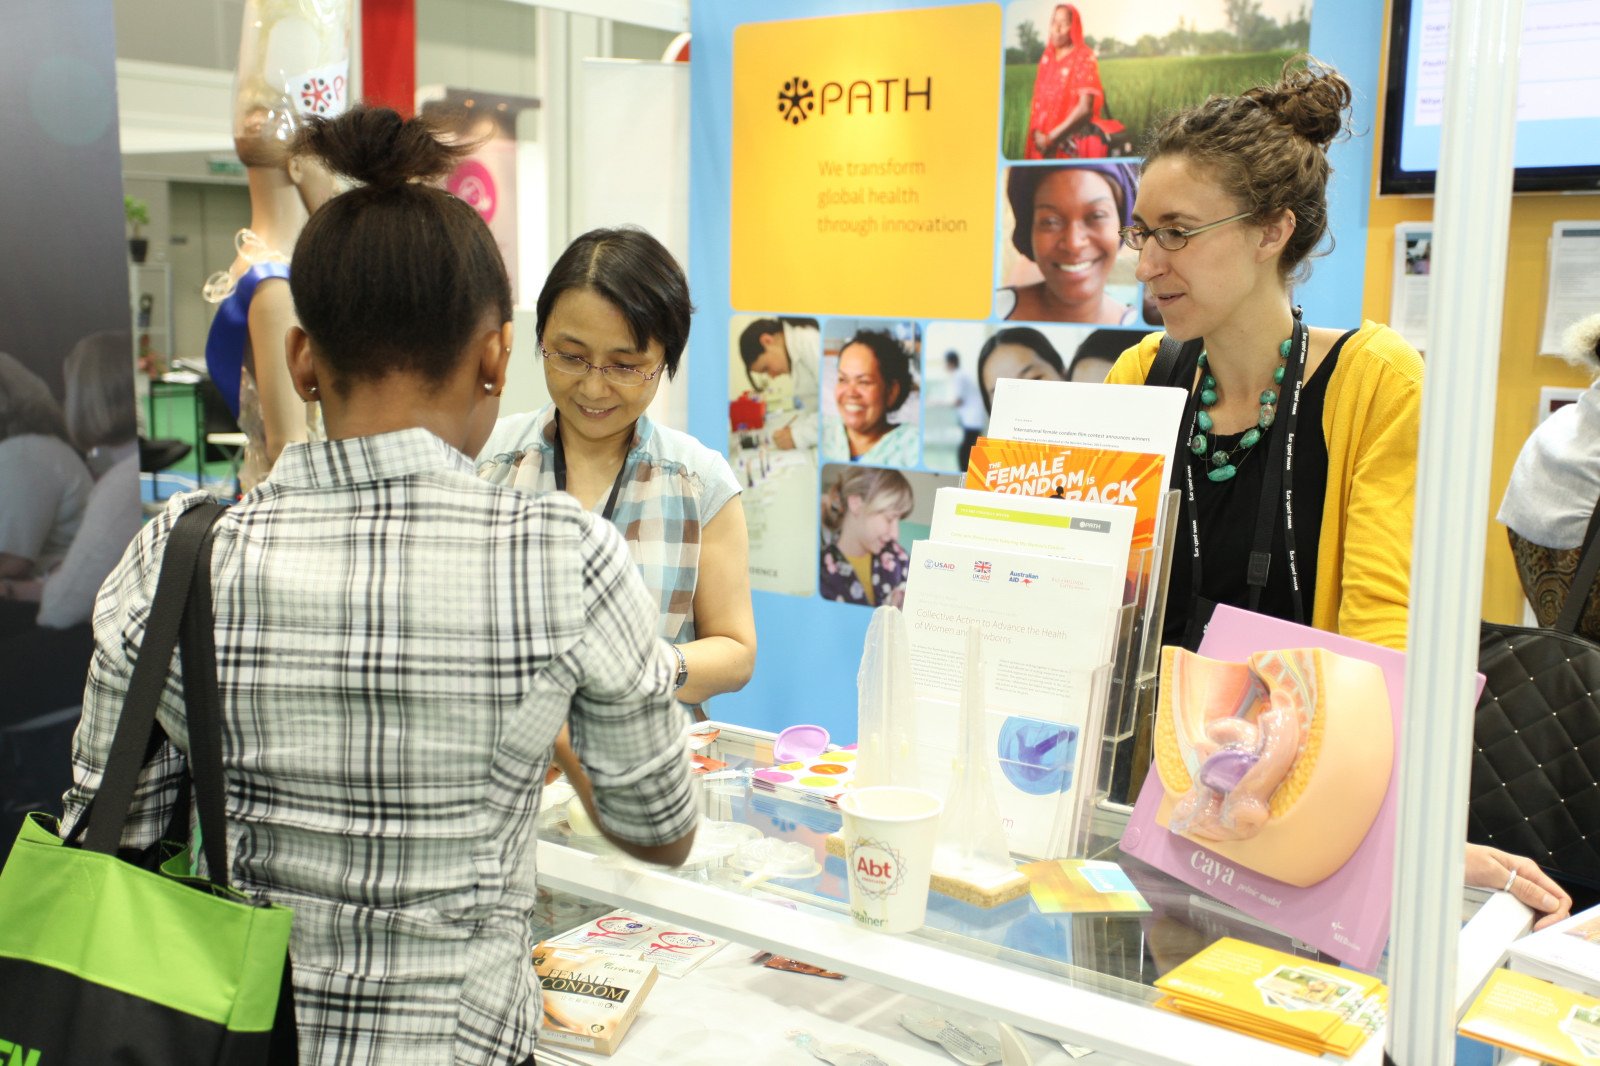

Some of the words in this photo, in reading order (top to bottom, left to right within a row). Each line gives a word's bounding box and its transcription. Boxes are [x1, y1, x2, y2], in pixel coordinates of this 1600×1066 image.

[820, 76, 932, 115] PATH
[818, 161, 844, 177] We
[846, 159, 926, 177] transform
[817, 188, 865, 208] global
[868, 186, 919, 205] health
[817, 217, 878, 237] through
[881, 217, 967, 233] innovation
[1014, 426, 1042, 434] International
[985, 456, 1065, 487] FEMALE
[988, 461, 1002, 470] THE
[1086, 476, 1096, 486] IS
[1084, 521, 1101, 530] PATH
[934, 561, 955, 570] USAID
[1009, 570, 1039, 580] Australian
[914, 622, 924, 630] of
[924, 622, 955, 634] Women
[916, 608, 955, 623] Collective
[955, 614, 981, 626] Action
[982, 620, 991, 628] to
[992, 620, 1026, 634] Advance
[1027, 625, 1040, 636] the
[1041, 626, 1068, 640] Health
[856, 856, 892, 879] Abt
[1190, 849, 1236, 886] Caya
[547, 967, 615, 986] FEMALE
[540, 976, 626, 1001] CONDOM
